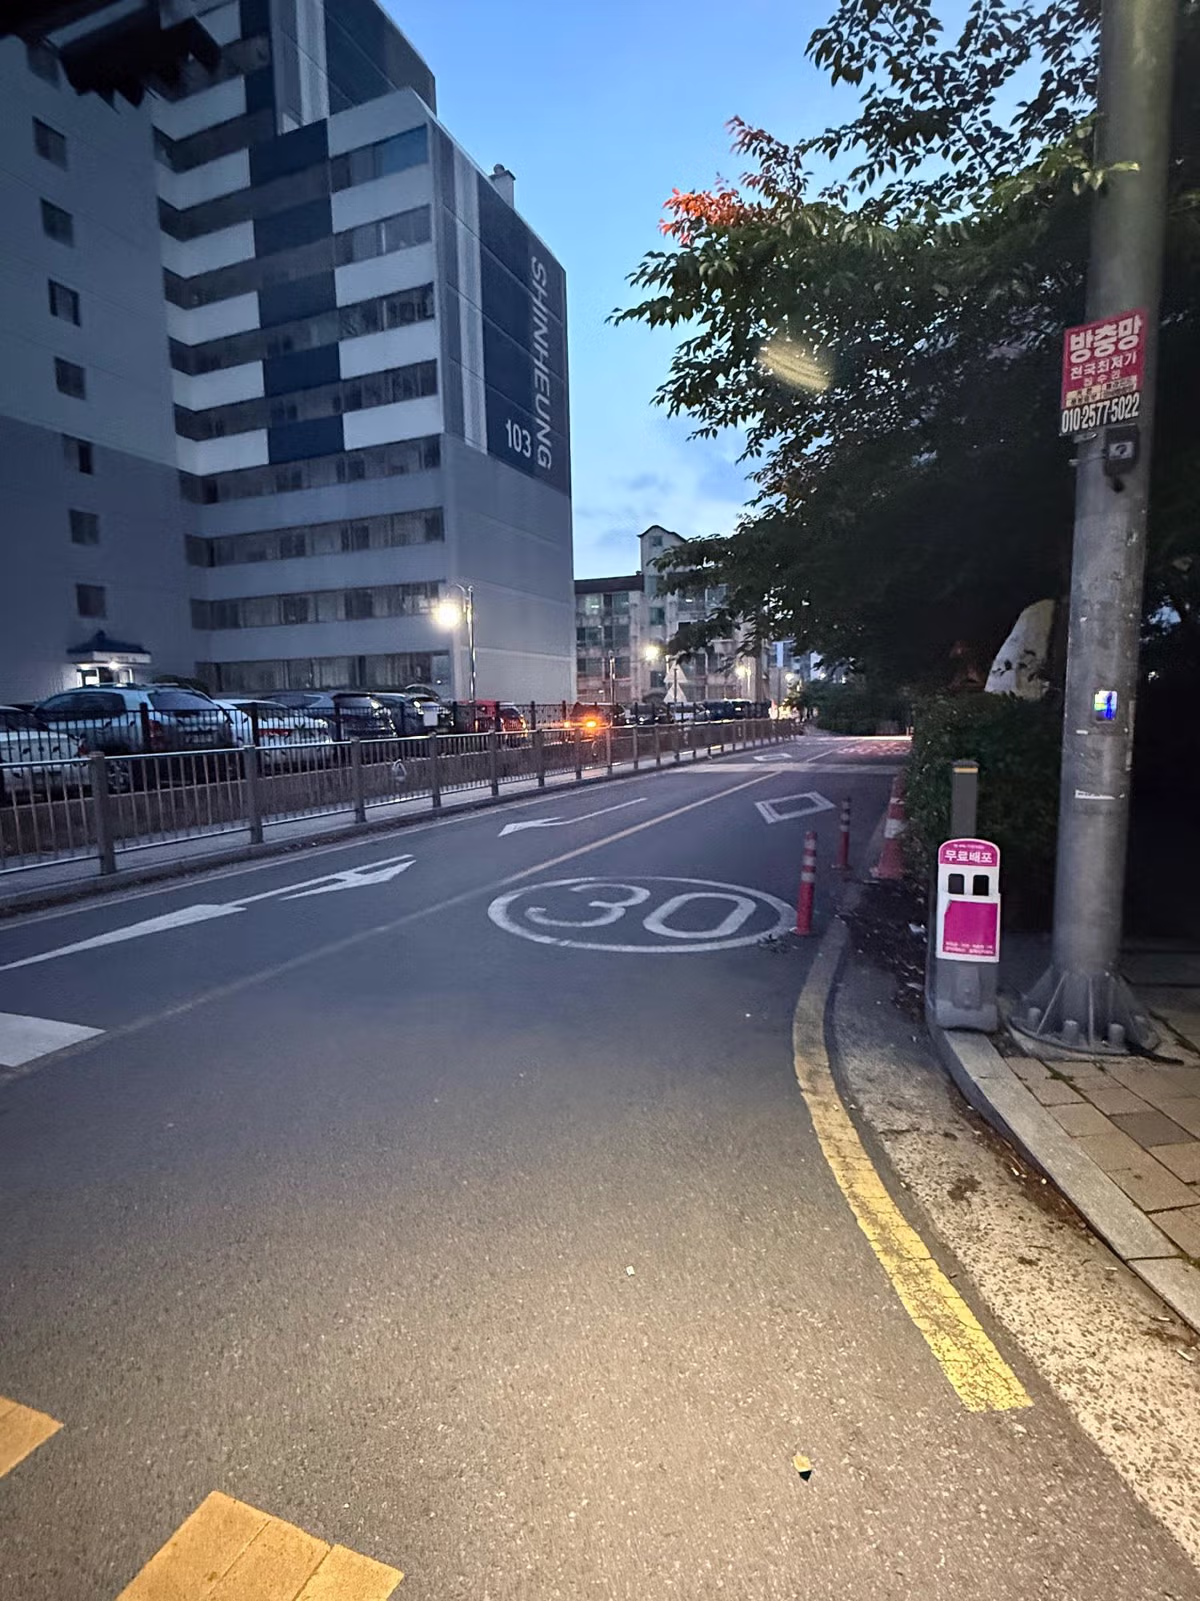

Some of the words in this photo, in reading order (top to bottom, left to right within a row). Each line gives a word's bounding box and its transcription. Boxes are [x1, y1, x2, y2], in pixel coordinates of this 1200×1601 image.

[1070, 314, 1142, 364] 방충망
[531, 256, 552, 468] SHINHEUNG
[1070, 351, 1137, 380] 전국최저가
[1061, 392, 1140, 433] 010-2577-5022
[505, 419, 531, 458] 103
[944, 849, 993, 863] 무료배포
[525, 884, 757, 938] 30
